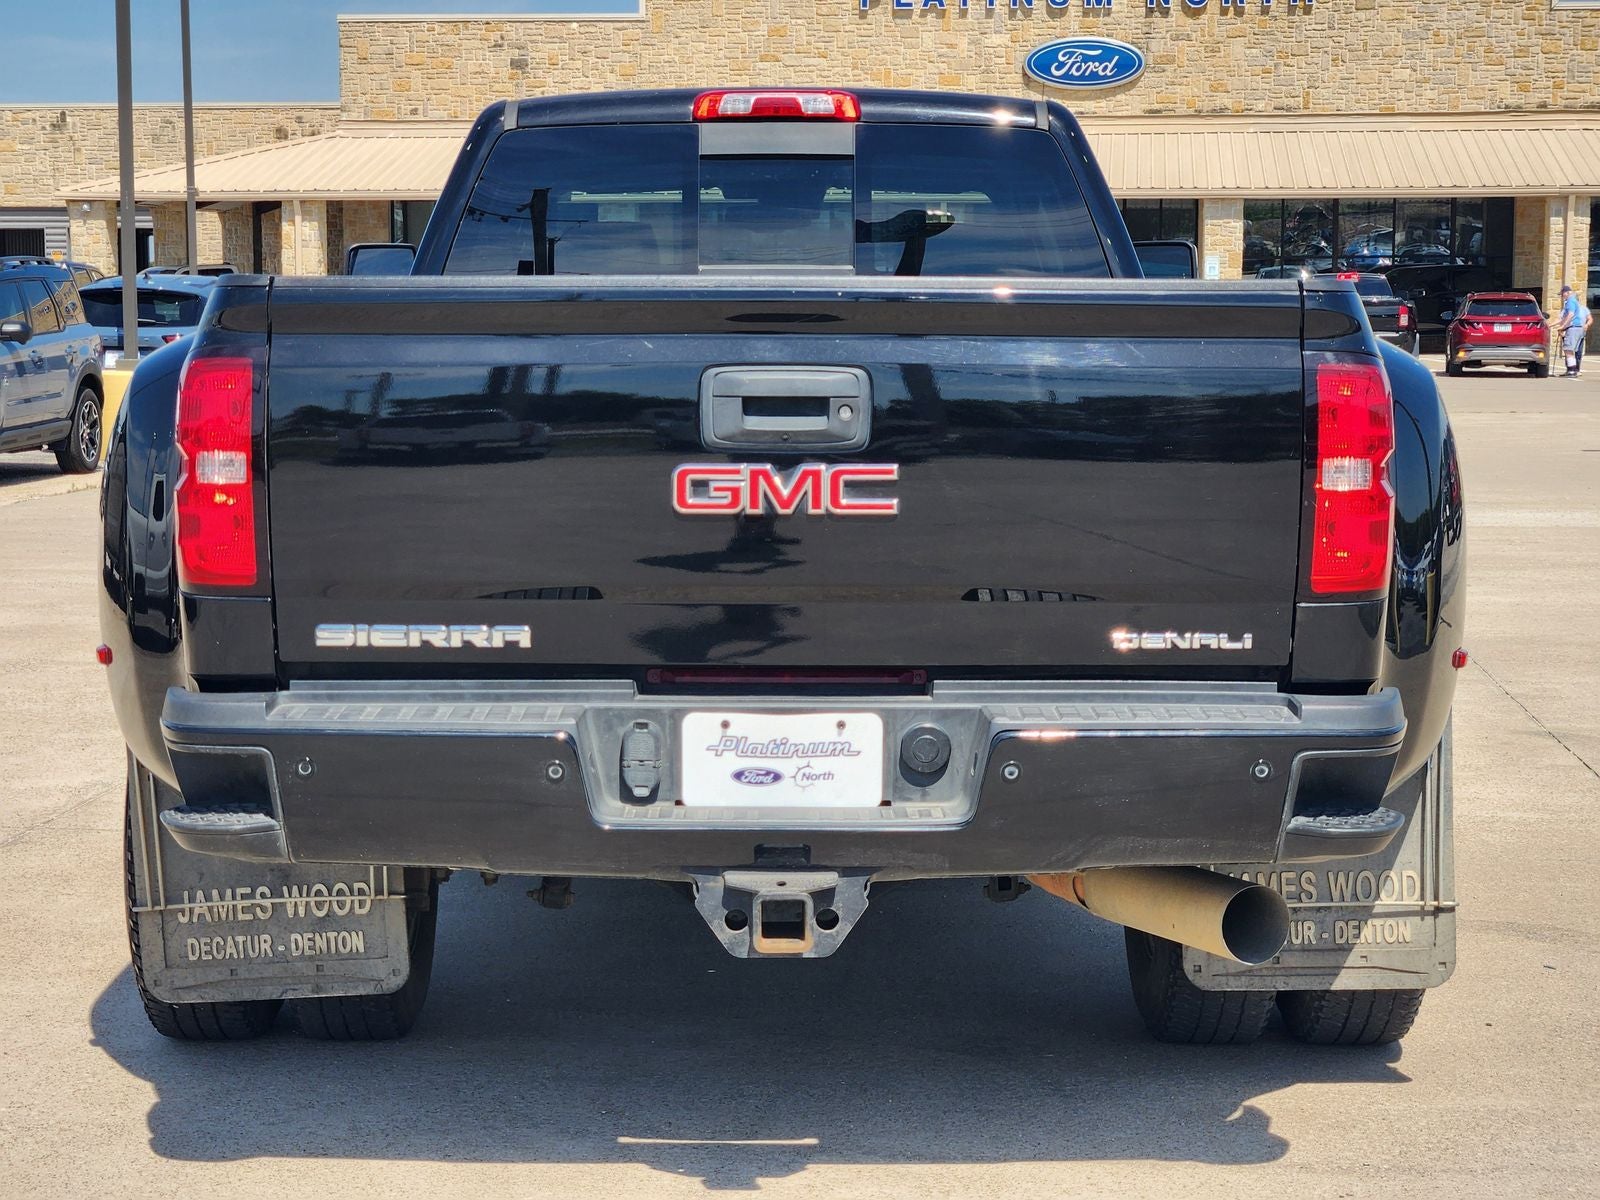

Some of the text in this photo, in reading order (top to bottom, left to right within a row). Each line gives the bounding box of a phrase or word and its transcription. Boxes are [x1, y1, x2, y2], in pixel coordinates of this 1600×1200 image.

[1050, 48, 1119, 77] Ford
[671, 463, 899, 515] GMC
[315, 624, 532, 648] SIERRA
[1111, 631, 1253, 650] DENALI
[706, 735, 862, 759] Platinum
[740, 769, 775, 785] Ford
[800, 771, 835, 783] North
[1328, 870, 1421, 903] WOOD
[177, 882, 372, 924] JAMES WOOD
[1334, 919, 1412, 945] DENTON
[187, 933, 273, 961] DECATUR
[291, 930, 365, 957] DENTON
